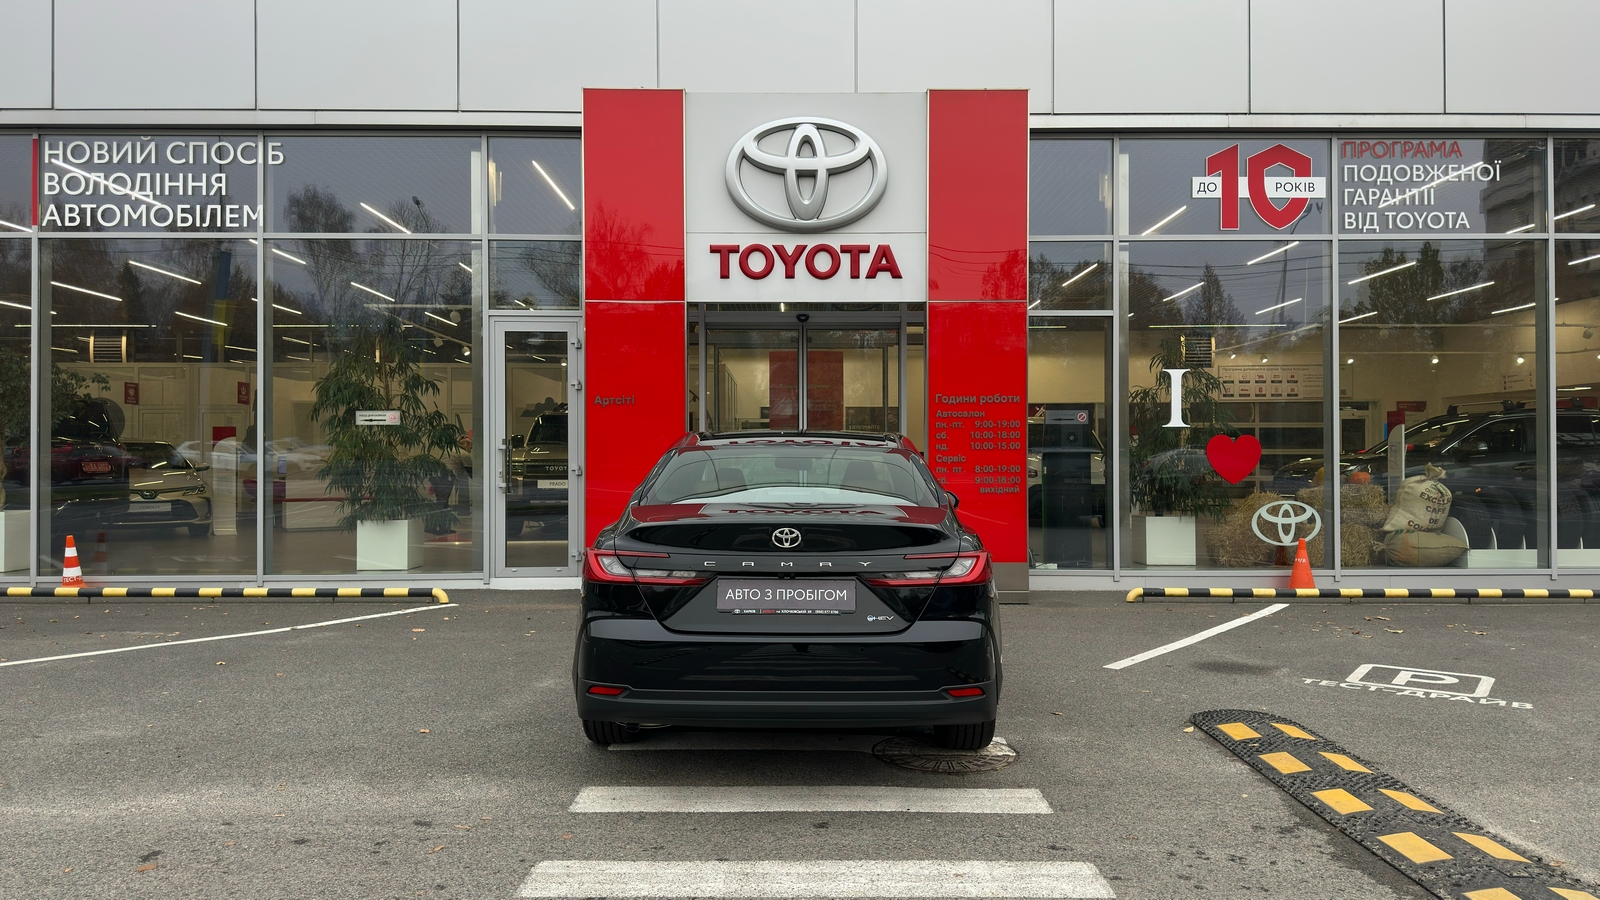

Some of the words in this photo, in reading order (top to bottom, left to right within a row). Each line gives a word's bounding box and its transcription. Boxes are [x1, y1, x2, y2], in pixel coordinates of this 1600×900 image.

[44, 135, 156, 164] НОВИЙ
[166, 141, 285, 165] СПОСІБ
[1342, 141, 1463, 158] ПРОГРАМА
[1344, 160, 1502, 185] ПОДОВЖЕНОЇ
[44, 172, 227, 200] ВОЛОДІННЯ
[1196, 182, 1218, 195] ДО
[1207, 143, 1312, 230] 10
[1275, 182, 1316, 193] РОКІВ
[1344, 185, 1436, 205] ГАРАНТІЇ
[42, 204, 264, 227] АВТОМОБІЛЕМ
[1344, 212, 1380, 232] ВІД
[1385, 212, 1470, 229] TOYOTA
[709, 243, 903, 280] TOYOTA
[594, 394, 635, 408] Артсіті
[935, 394, 977, 404] Години
[980, 393, 1020, 405] роботи
[936, 410, 985, 418] Автосалон
[974, 420, 1020, 428] 9:00-19:00
[935, 431, 949, 439] сб.
[970, 431, 1020, 439] 10:00-18:00
[970, 442, 1020, 450] 10:00-15:00
[936, 454, 966, 463] Сервіс
[974, 465, 1020, 473] 8:00-19:00
[974, 476, 1020, 484] 9:00-18:00
[980, 486, 1020, 494] вихідний
[1429, 517, 1440, 525] DE
[725, 588, 761, 601] АВТО
[776, 588, 847, 601] ПРОБІГОМ
[1392, 670, 1460, 686] P
[1301, 677, 1534, 709] ТЕСТ-ДРАЙВ
